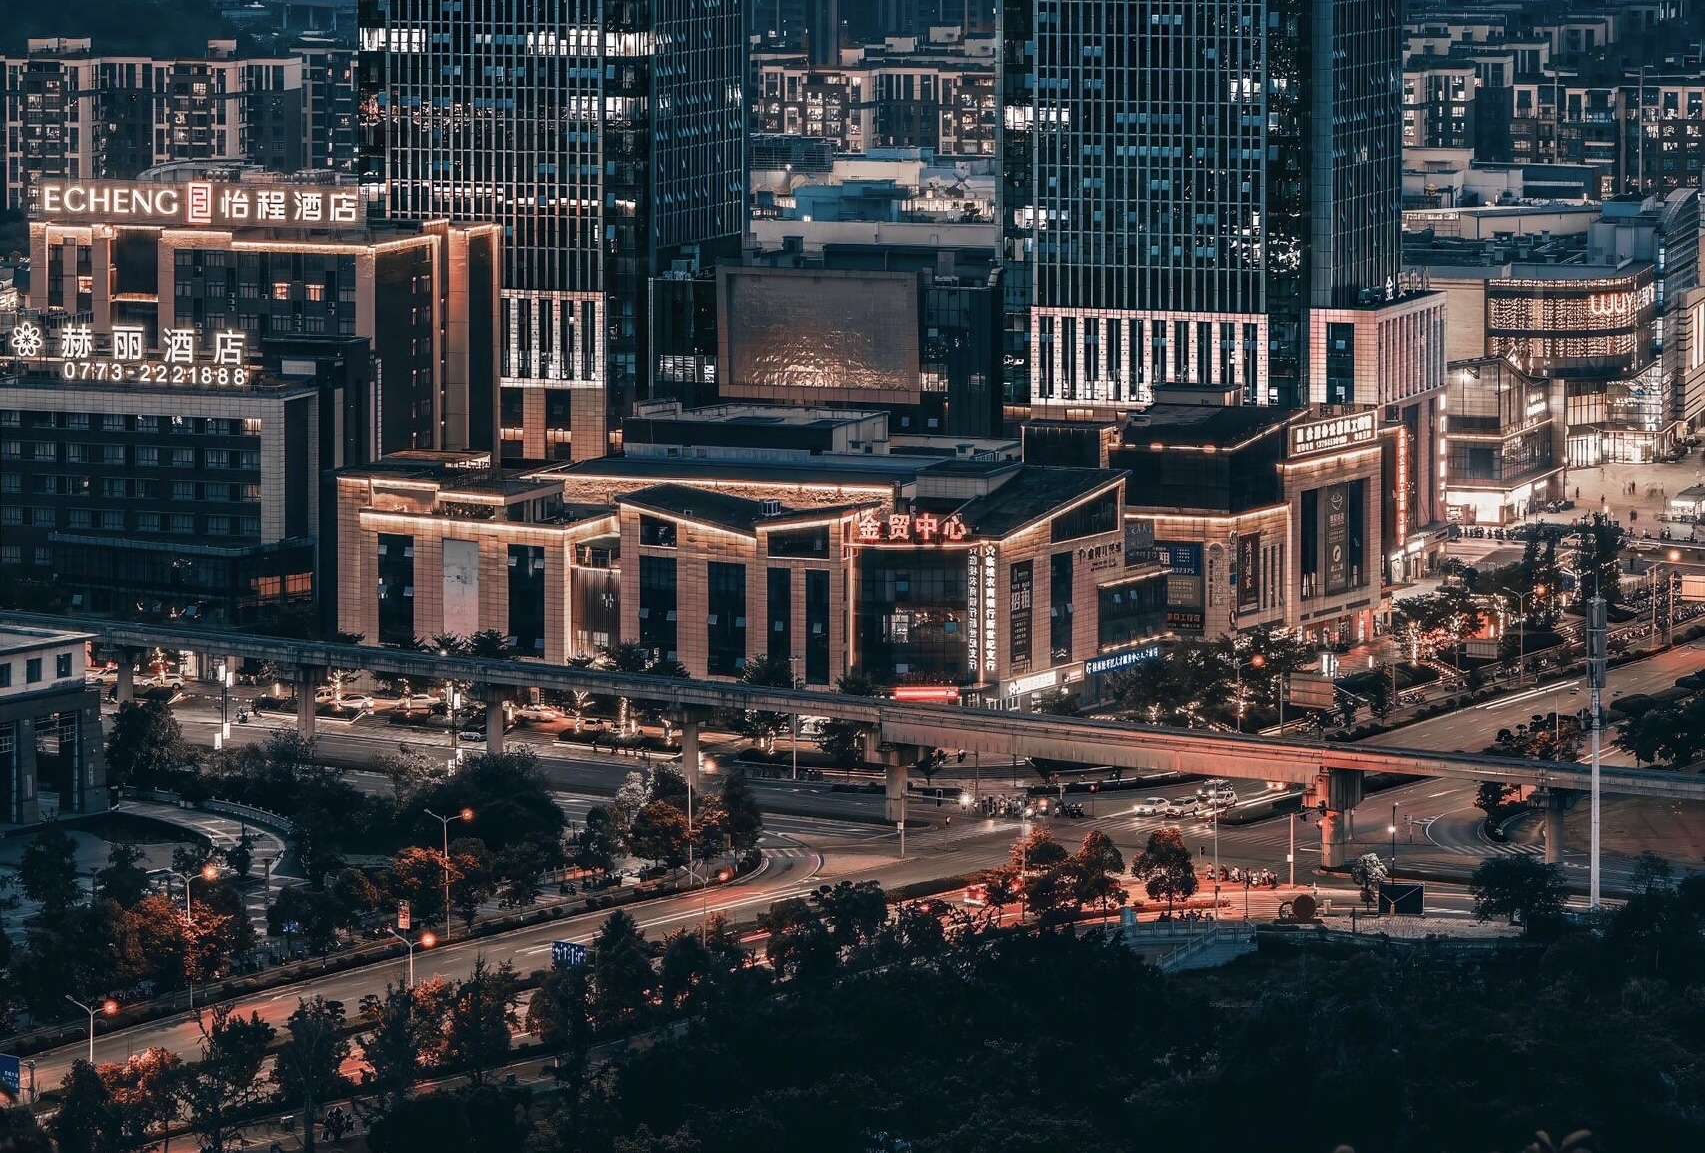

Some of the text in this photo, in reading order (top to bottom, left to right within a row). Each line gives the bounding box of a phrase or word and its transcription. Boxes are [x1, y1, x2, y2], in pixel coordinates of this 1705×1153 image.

[44, 186, 179, 215] ECHENG
[221, 189, 357, 222] 怡程酒店
[61, 323, 246, 365] 赫丽酒店
[63, 362, 246, 386] 0773-2221888
[858, 513, 967, 540] 金贸中心
[1011, 589, 1031, 612] 招租
